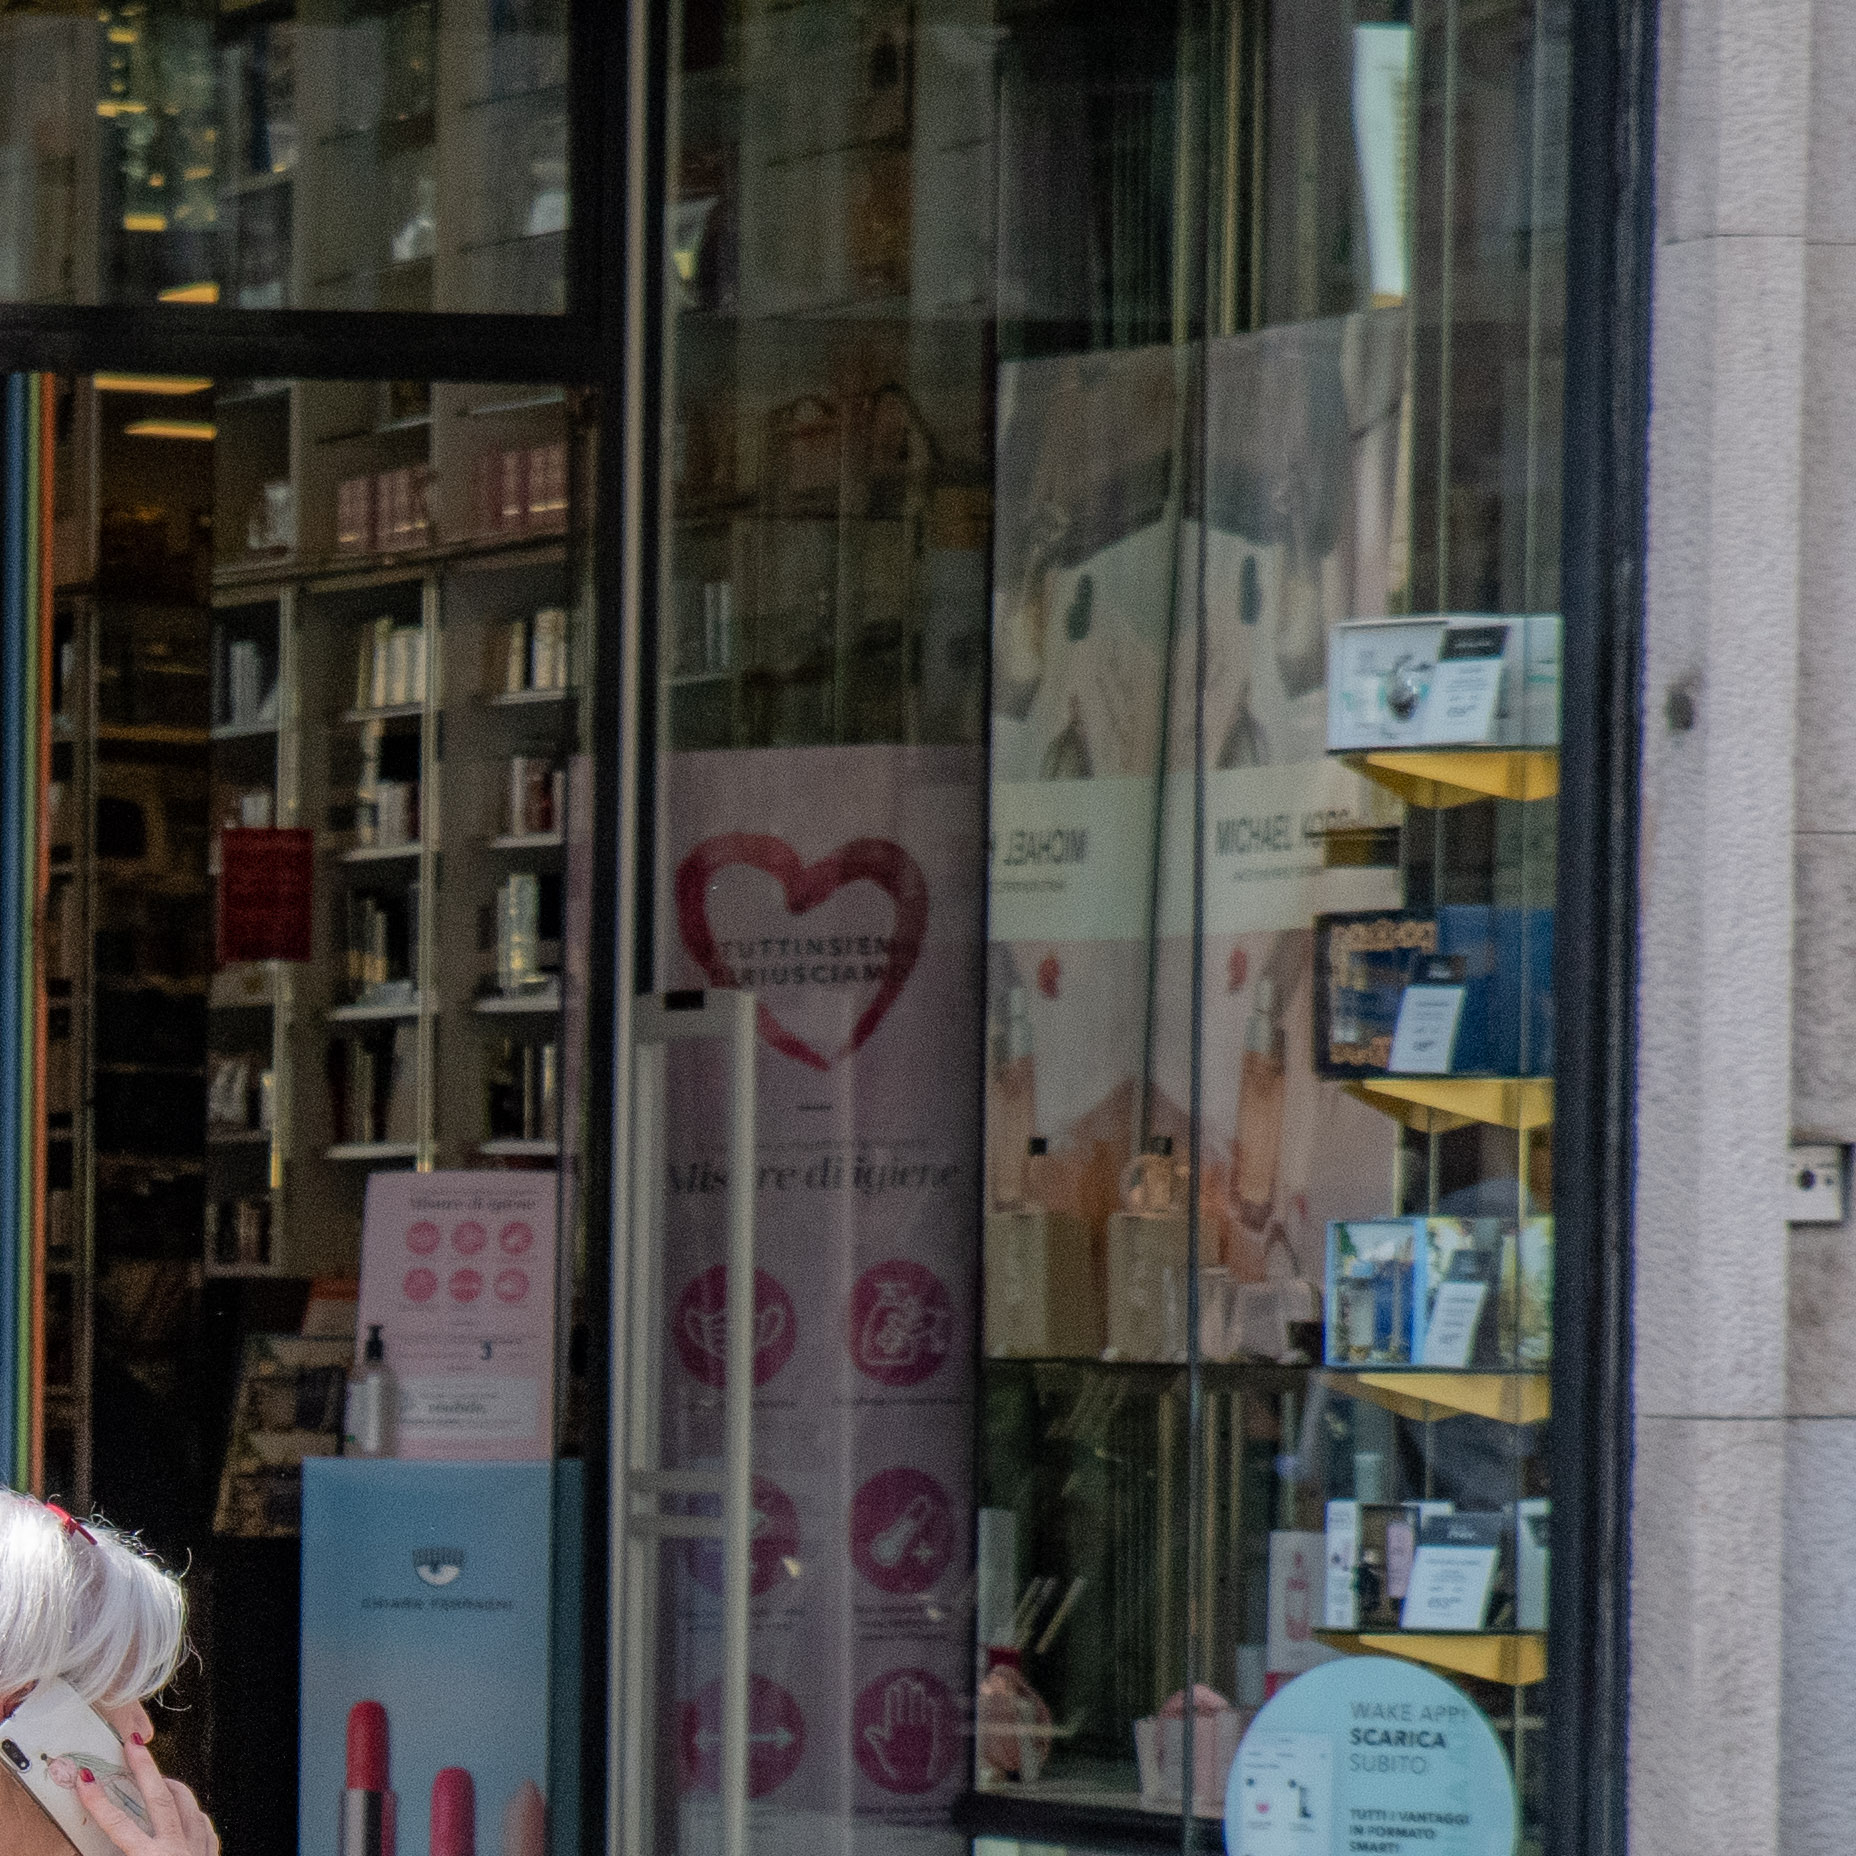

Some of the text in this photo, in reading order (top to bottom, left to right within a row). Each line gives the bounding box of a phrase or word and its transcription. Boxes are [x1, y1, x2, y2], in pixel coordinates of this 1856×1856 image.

[1215, 814, 1293, 854] MICHAEL
[669, 1161, 796, 1193] Misre
[1350, 1701, 1413, 1722] WAKE
[1349, 1726, 1448, 1749] SCARICA
[1349, 1752, 1428, 1775] SUBITO
[1349, 1807, 1388, 1822] TUTTI
[1398, 1810, 1470, 1827] VANTAGGI
[1349, 1824, 1437, 1841] IN FORMATO
